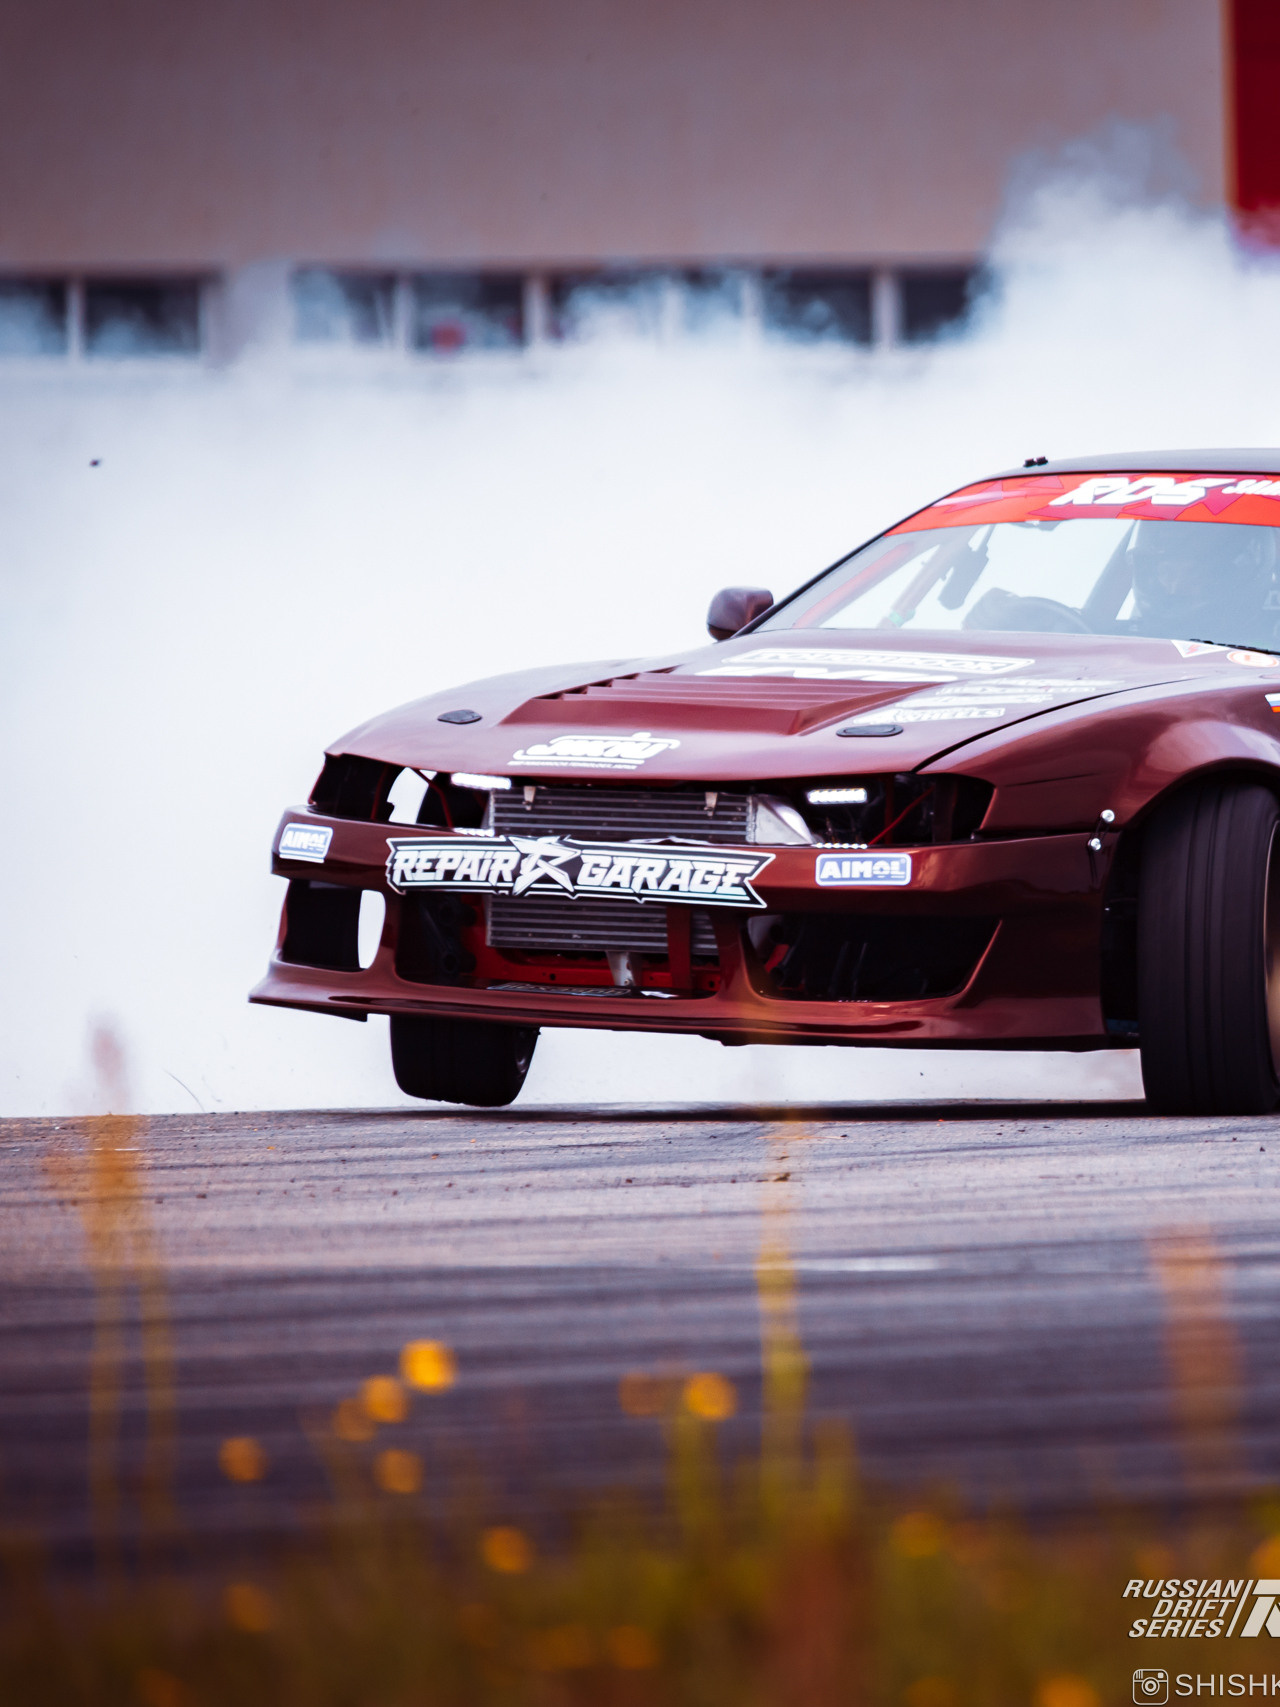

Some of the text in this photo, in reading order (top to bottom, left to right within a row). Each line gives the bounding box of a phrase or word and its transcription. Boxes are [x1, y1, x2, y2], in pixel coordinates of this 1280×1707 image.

[1048, 477, 1238, 505] RDS
[281, 830, 328, 850] AIMOL
[392, 850, 521, 886] REPAIR
[576, 854, 756, 896] GARAGE
[819, 859, 906, 880] AIMOL
